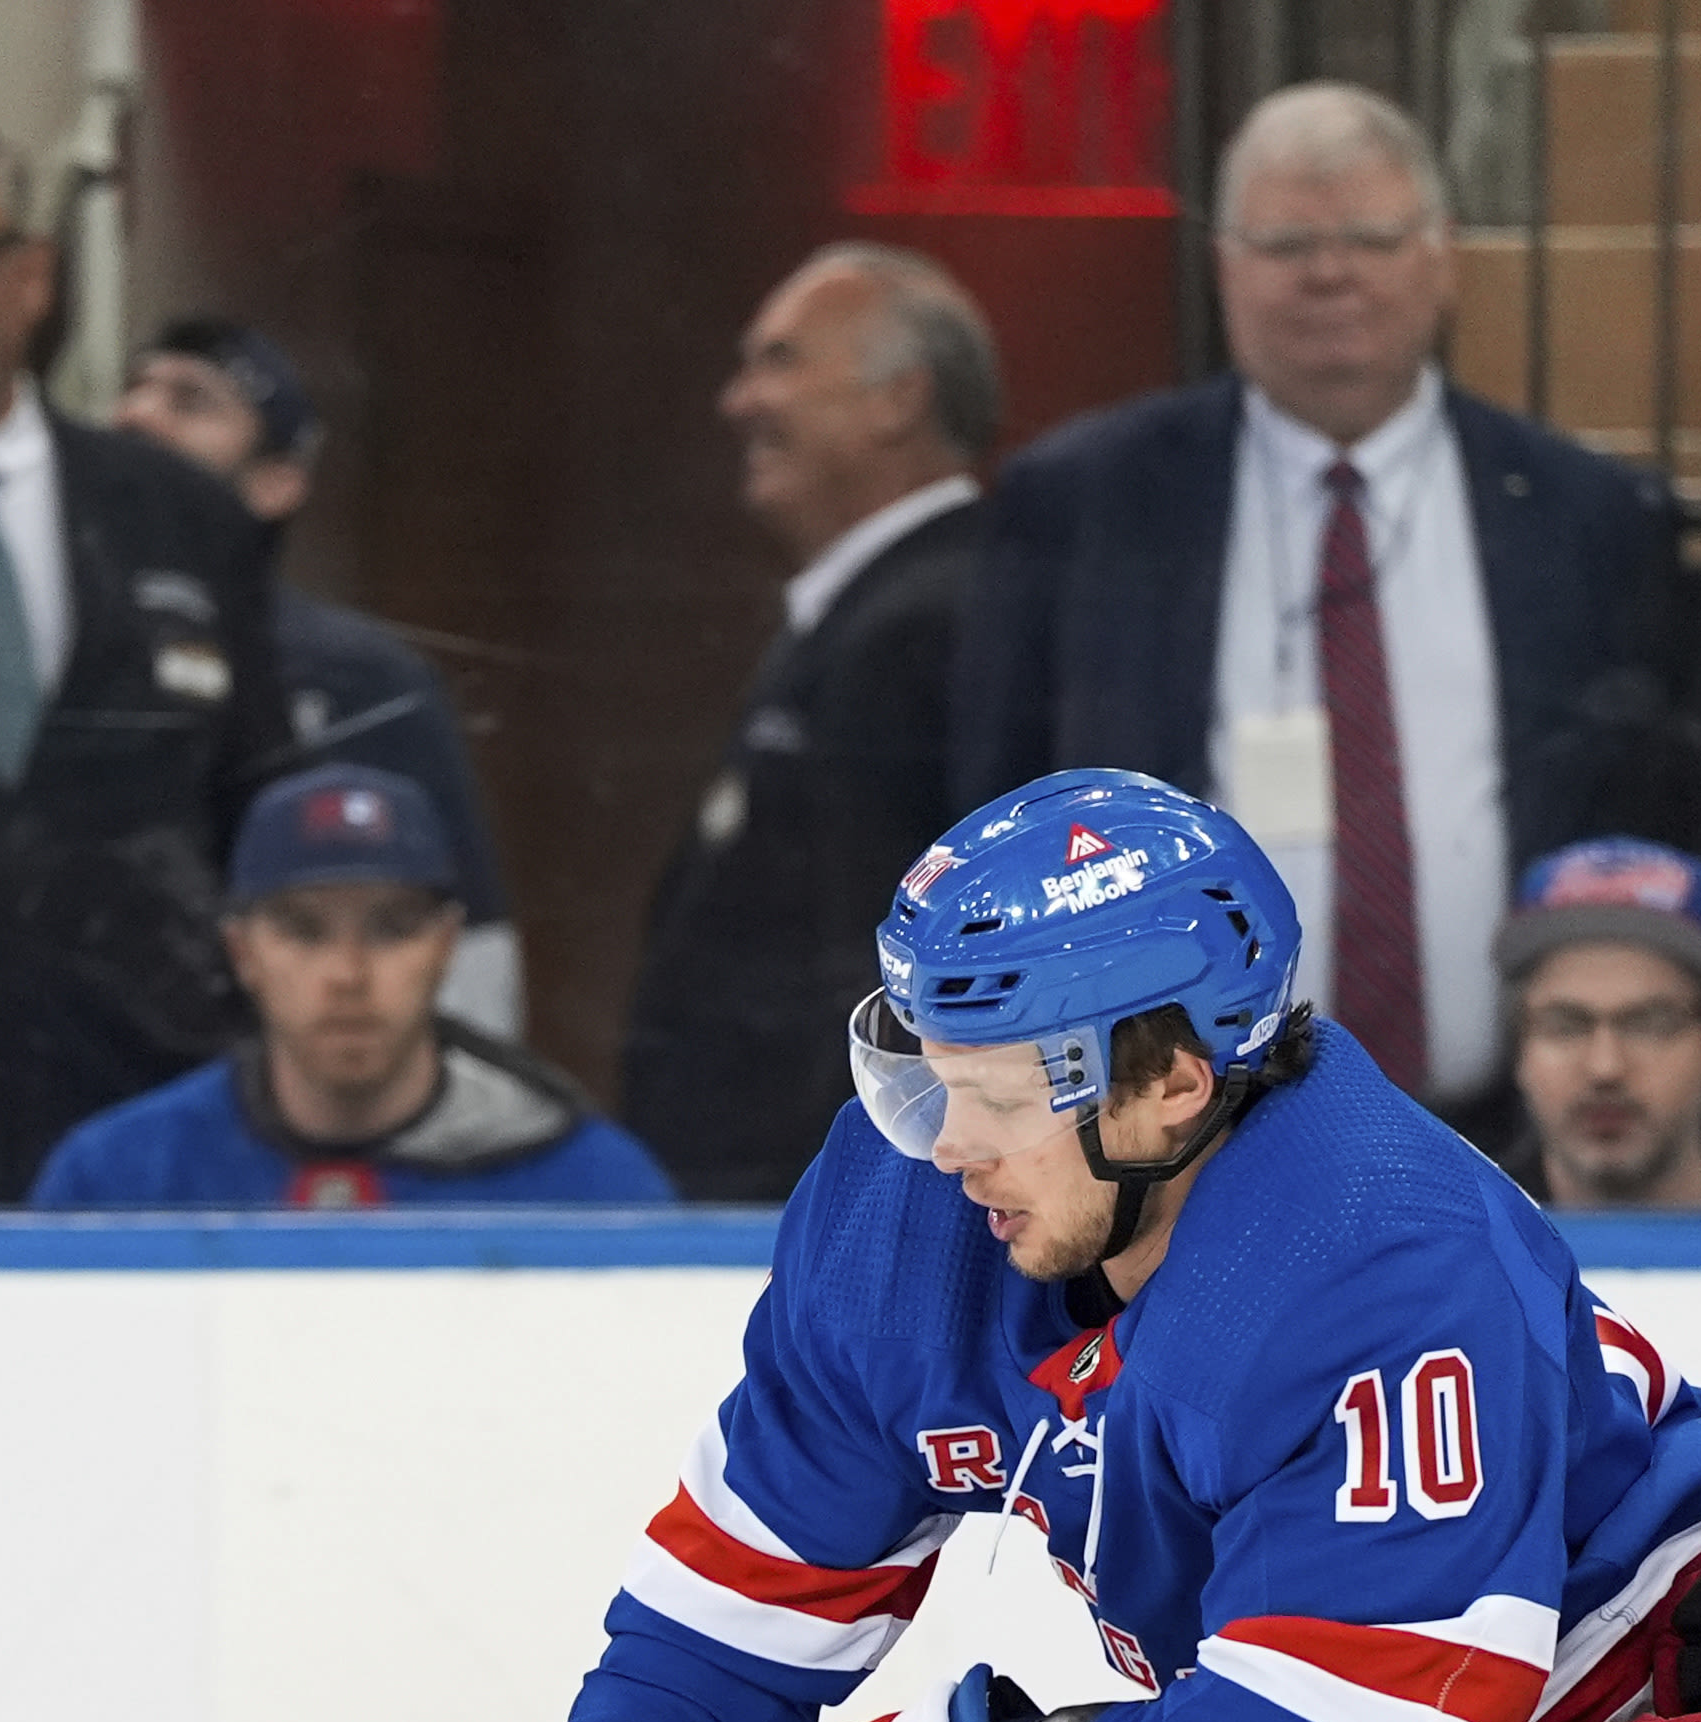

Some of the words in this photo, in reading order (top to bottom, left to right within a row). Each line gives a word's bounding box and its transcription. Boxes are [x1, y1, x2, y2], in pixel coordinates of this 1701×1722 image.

[1041, 848, 1149, 899] Benjamin
[1067, 876, 1144, 914] Moore
[1333, 1347, 1485, 1523] 10
